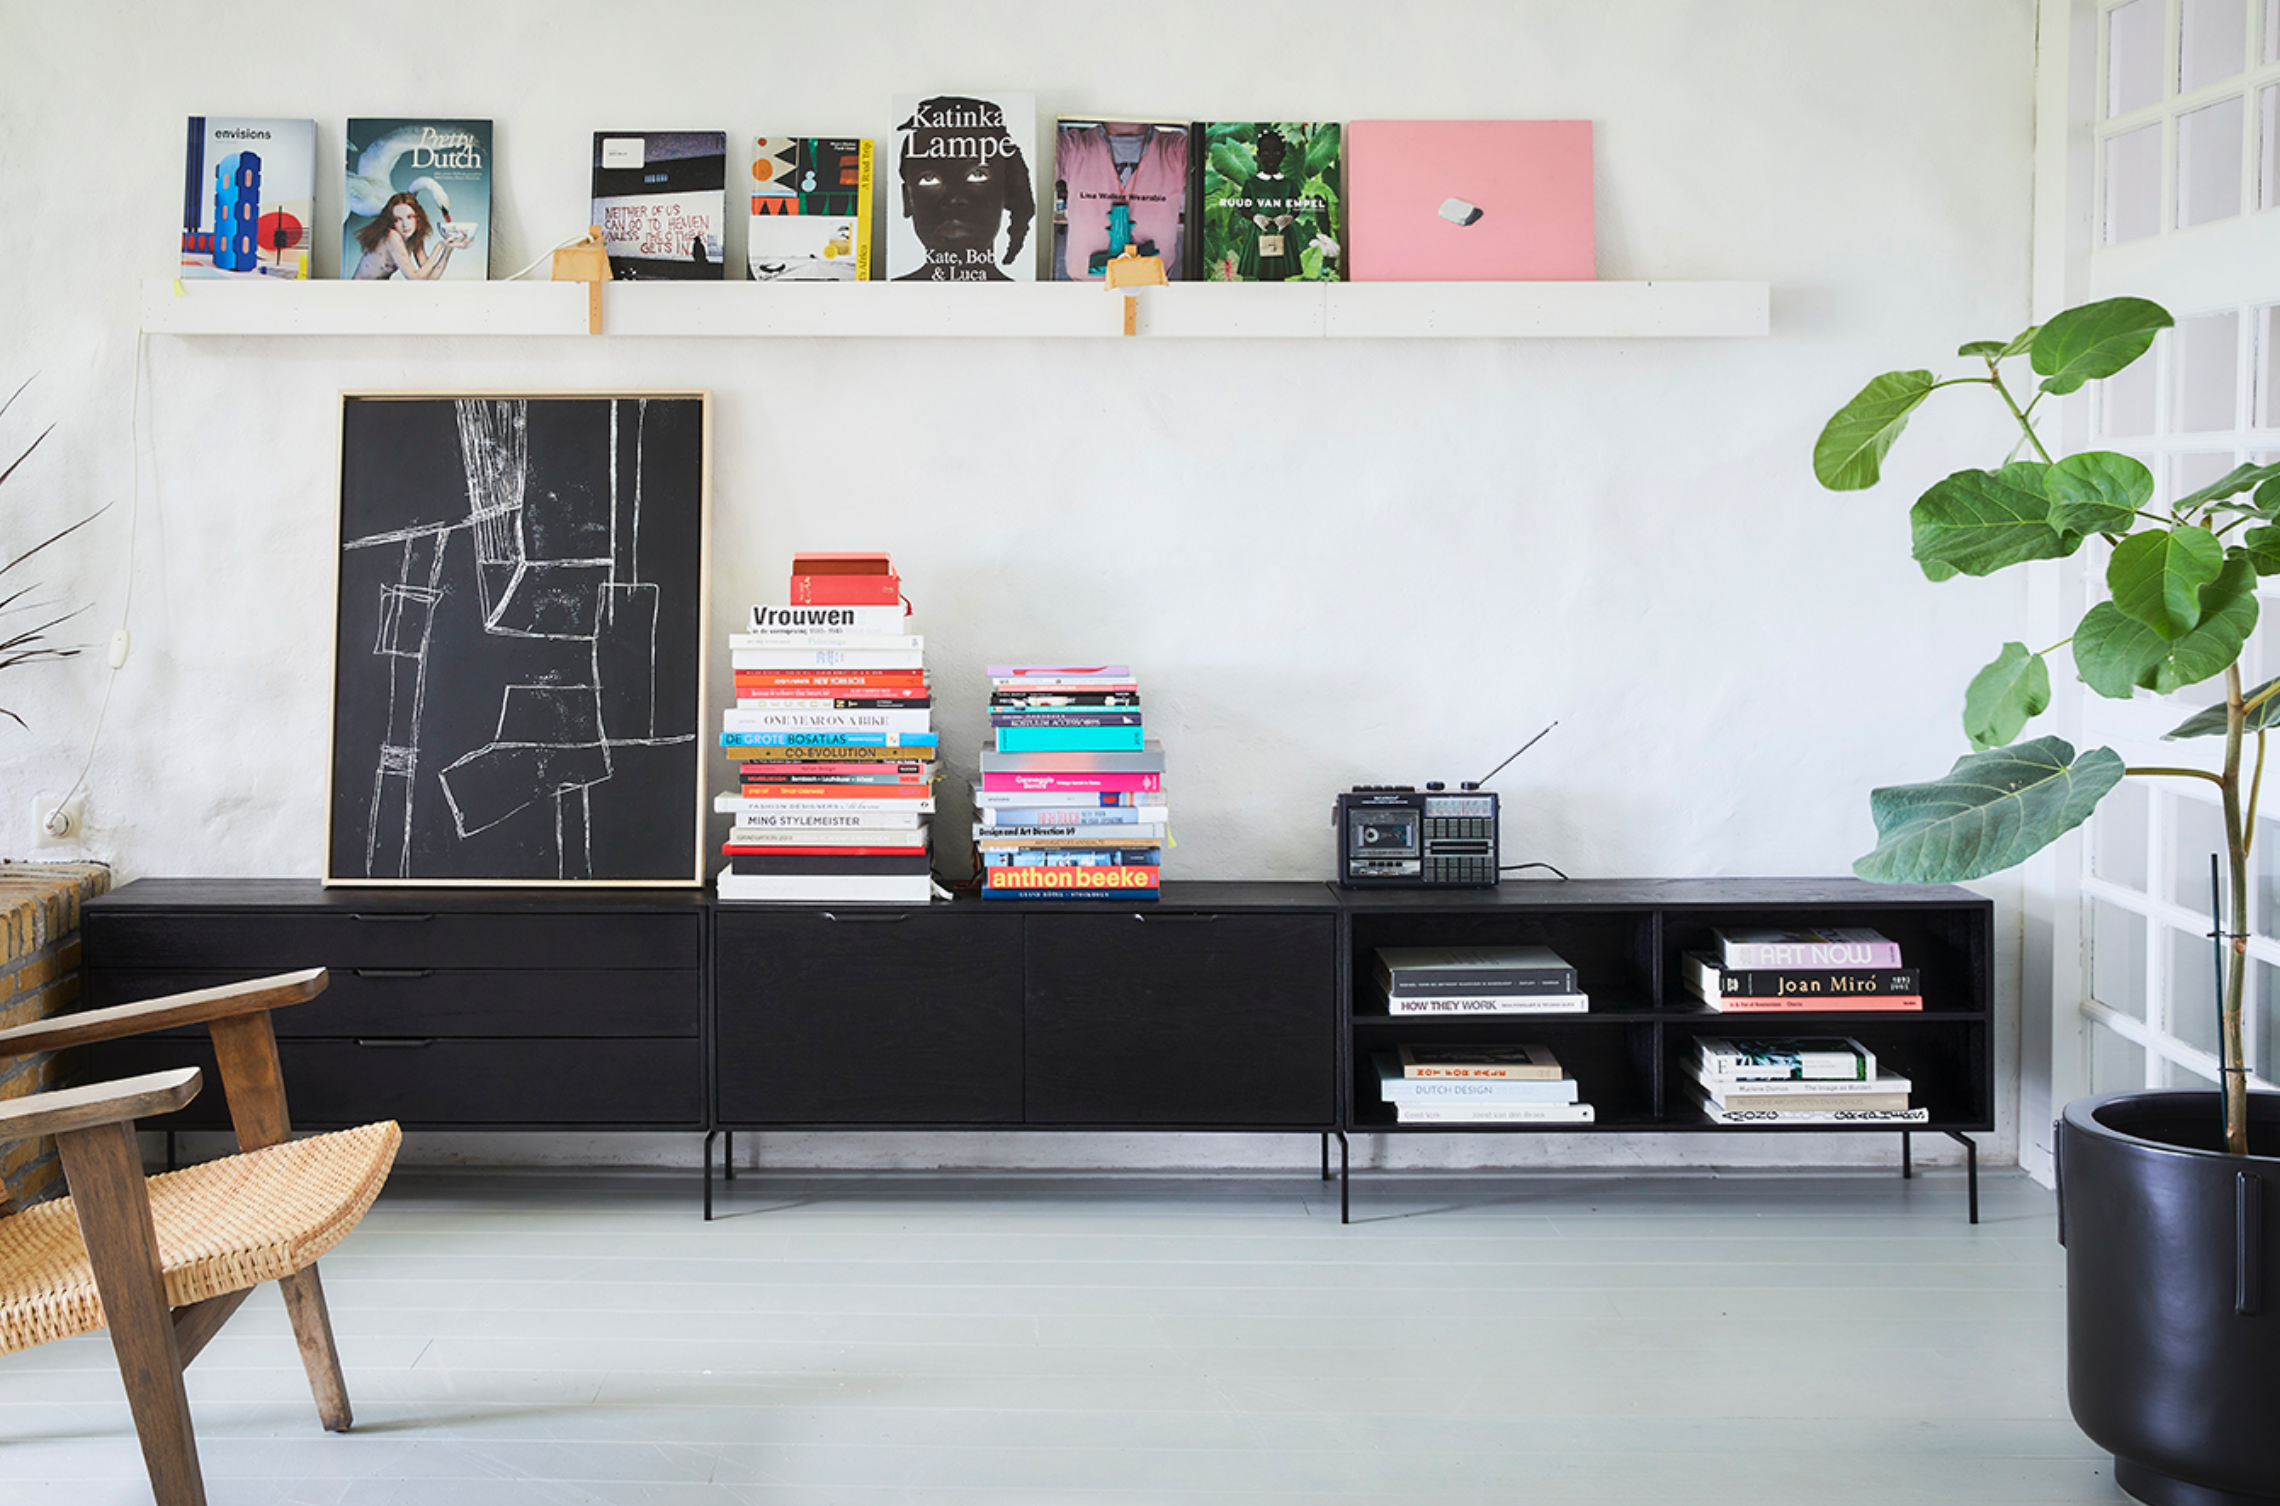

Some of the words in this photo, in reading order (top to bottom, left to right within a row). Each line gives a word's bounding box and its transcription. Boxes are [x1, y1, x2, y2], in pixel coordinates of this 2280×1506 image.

[911, 104, 1007, 129] Katinka
[215, 127, 272, 140] envisions
[421, 126, 475, 155] Pretty
[904, 129, 1017, 167] Lampe
[410, 145, 483, 169] Dutch
[1218, 198, 1253, 208] RUUD
[1257, 198, 1282, 208] VAN
[1285, 198, 1327, 209] EMPEL
[604, 205, 648, 219] NEITHER
[651, 204, 664, 217] OF
[666, 203, 681, 217] US
[604, 219, 626, 231] CAN
[628, 218, 643, 231] GO
[647, 218, 662, 231] TO
[640, 242, 672, 255] GETS
[924, 248, 963, 266] Kate,
[965, 248, 997, 265] Bob
[931, 267, 946, 282] &
[950, 266, 988, 282] Luca
[753, 606, 855, 627] Vrouwen
[763, 715, 791, 727] ONE
[792, 715, 825, 727] YEAR
[826, 715, 845, 727] ON
[849, 715, 858, 727] A
[859, 715, 889, 727] BIKE
[725, 733, 742, 745] DE
[744, 733, 785, 745] GROTE
[787, 733, 847, 745] BOSATLAS
[747, 815, 778, 826] MING
[780, 815, 861, 827] STYLEMEISTER
[979, 827, 1003, 837] Design
[1004, 827, 1018, 836] and
[1020, 827, 1031, 836] Art
[1033, 827, 1065, 836] Direction
[992, 866, 1072, 887] anthon
[1076, 866, 1149, 887] beeke
[1760, 944, 1806, 965] ART
[1811, 944, 1873, 965] NOW
[1777, 976, 1821, 996] Joan
[1830, 974, 1877, 992] Miró
[1400, 1001, 1428, 1011] HOW
[1430, 1000, 1460, 1011] THEY
[1462, 1000, 1497, 1010] WORK
[1417, 1068, 1440, 1077] NOT
[1445, 1068, 1470, 1077] FOR
[1473, 1068, 1507, 1077] SALE
[1416, 1085, 1452, 1095] DUTCH
[1454, 1085, 1493, 1095] DESIGN
[1766, 1084, 1789, 1092] Dumas
[1819, 1084, 1838, 1093] Image
[1848, 1083, 1873, 1091] Burden
